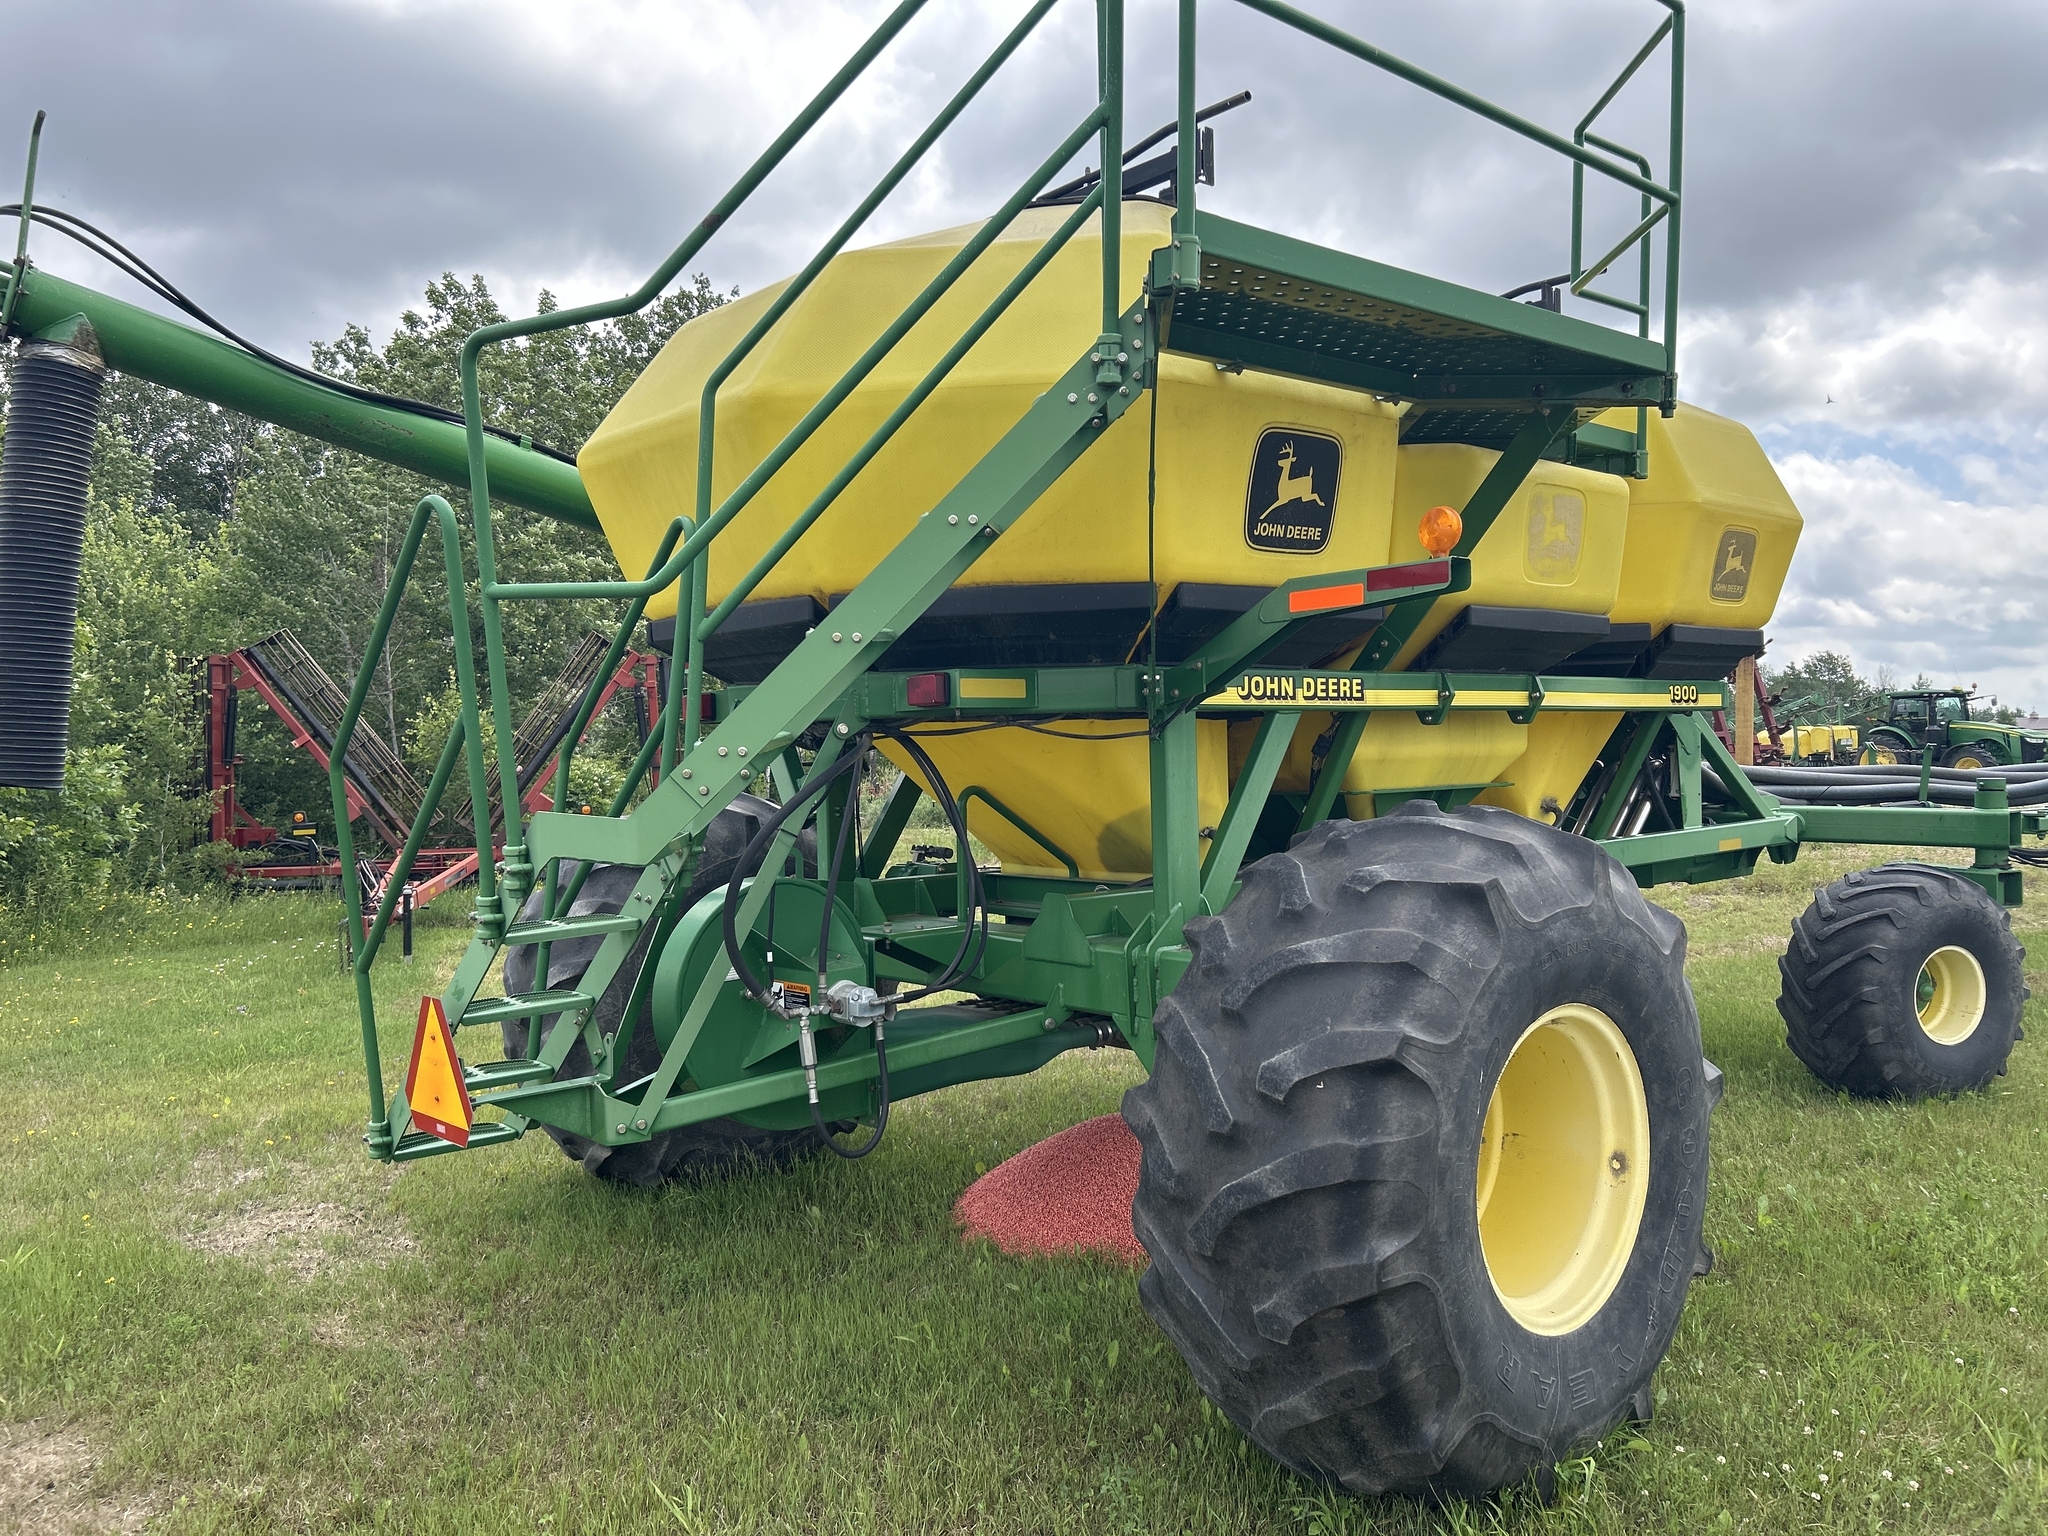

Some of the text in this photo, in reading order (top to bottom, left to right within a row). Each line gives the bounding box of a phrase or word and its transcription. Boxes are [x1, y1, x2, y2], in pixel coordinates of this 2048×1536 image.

[1253, 522, 1323, 541] JOHN DEERE
[1713, 582, 1744, 594] JOHN DEERE
[1237, 675, 1364, 702] JOHN DEERE
[1669, 684, 1699, 704] 1900
[1540, 937, 1592, 971] DYNA
